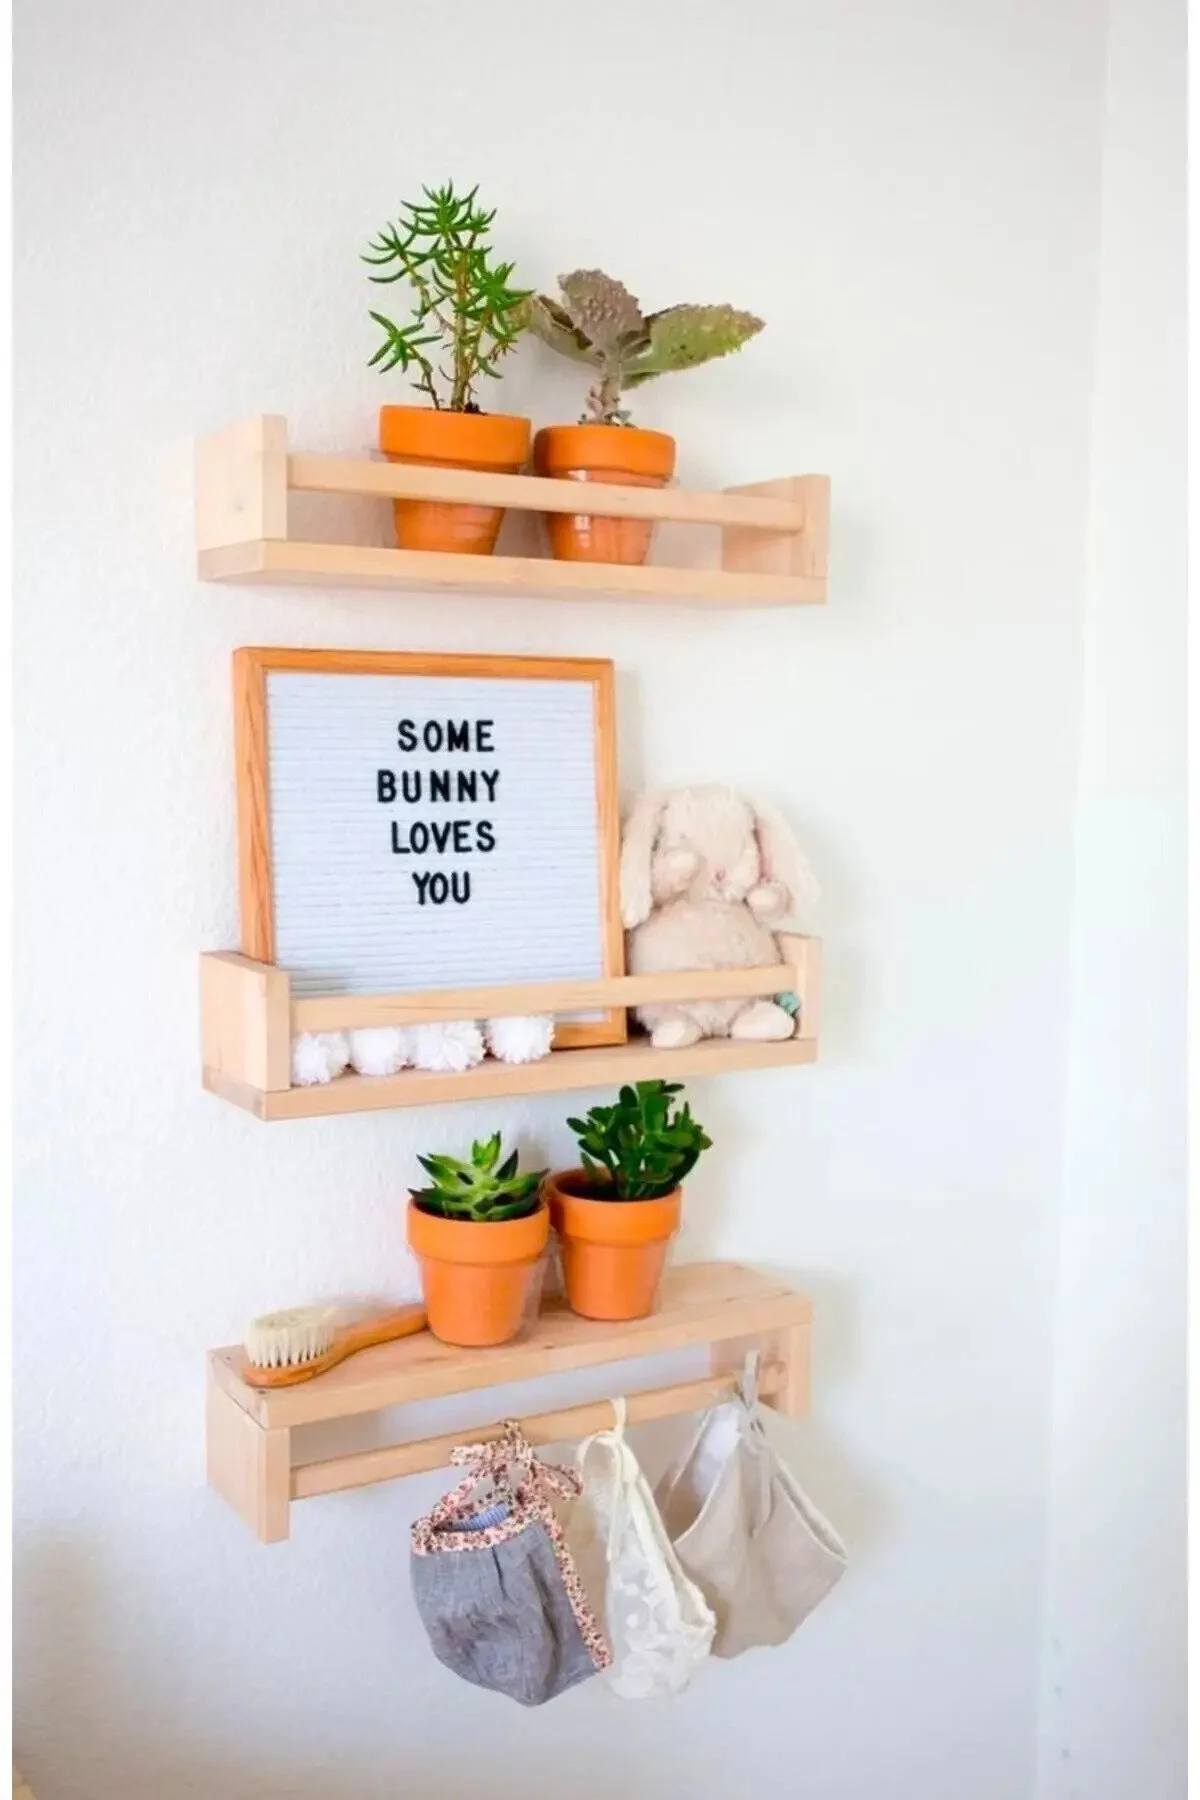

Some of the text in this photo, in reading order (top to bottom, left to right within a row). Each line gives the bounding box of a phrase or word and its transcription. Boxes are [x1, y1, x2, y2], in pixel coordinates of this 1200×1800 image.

[397, 719, 495, 753] SOME
[377, 769, 500, 804] BUNNY
[391, 820, 496, 855] LOVES
[411, 871, 471, 906] YOU
